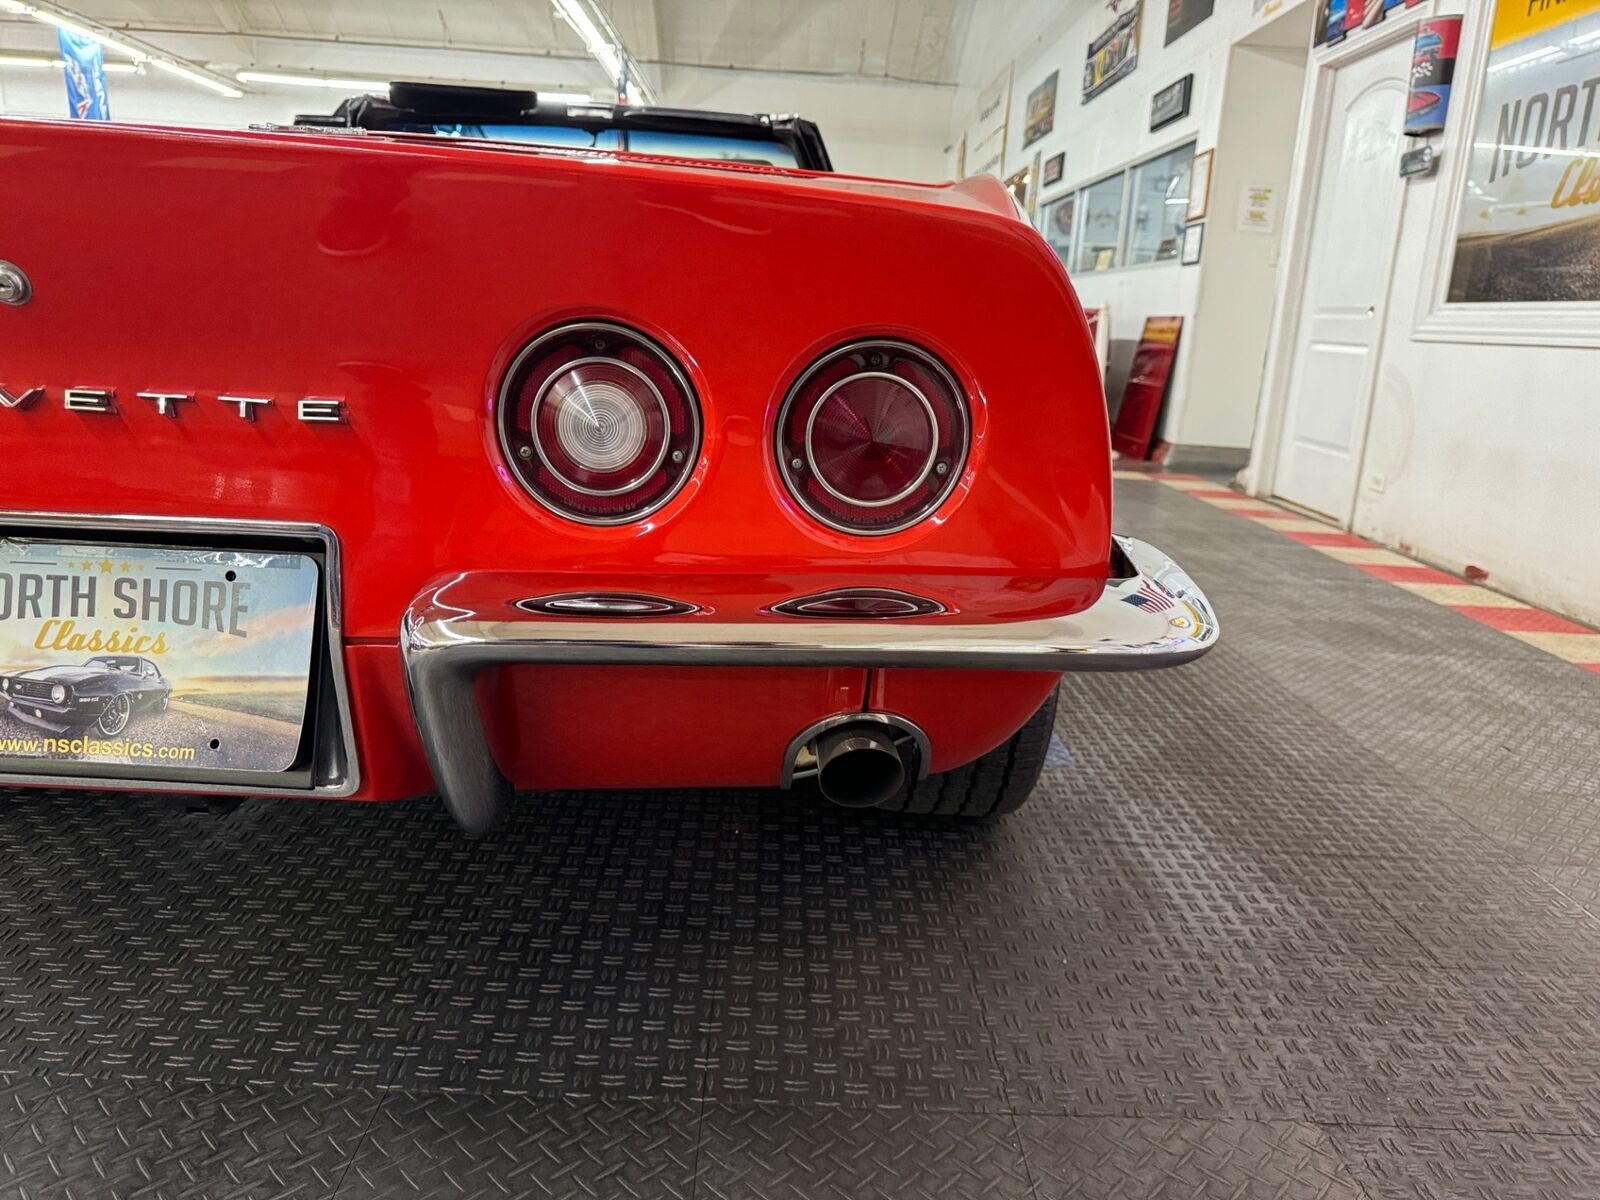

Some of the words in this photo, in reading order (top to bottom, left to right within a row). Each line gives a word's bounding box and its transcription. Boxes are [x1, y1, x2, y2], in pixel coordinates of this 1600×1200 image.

[1489, 77, 1600, 183] NORT
[34, 619, 170, 655] Classics
[113, 577, 251, 639] SHORE
